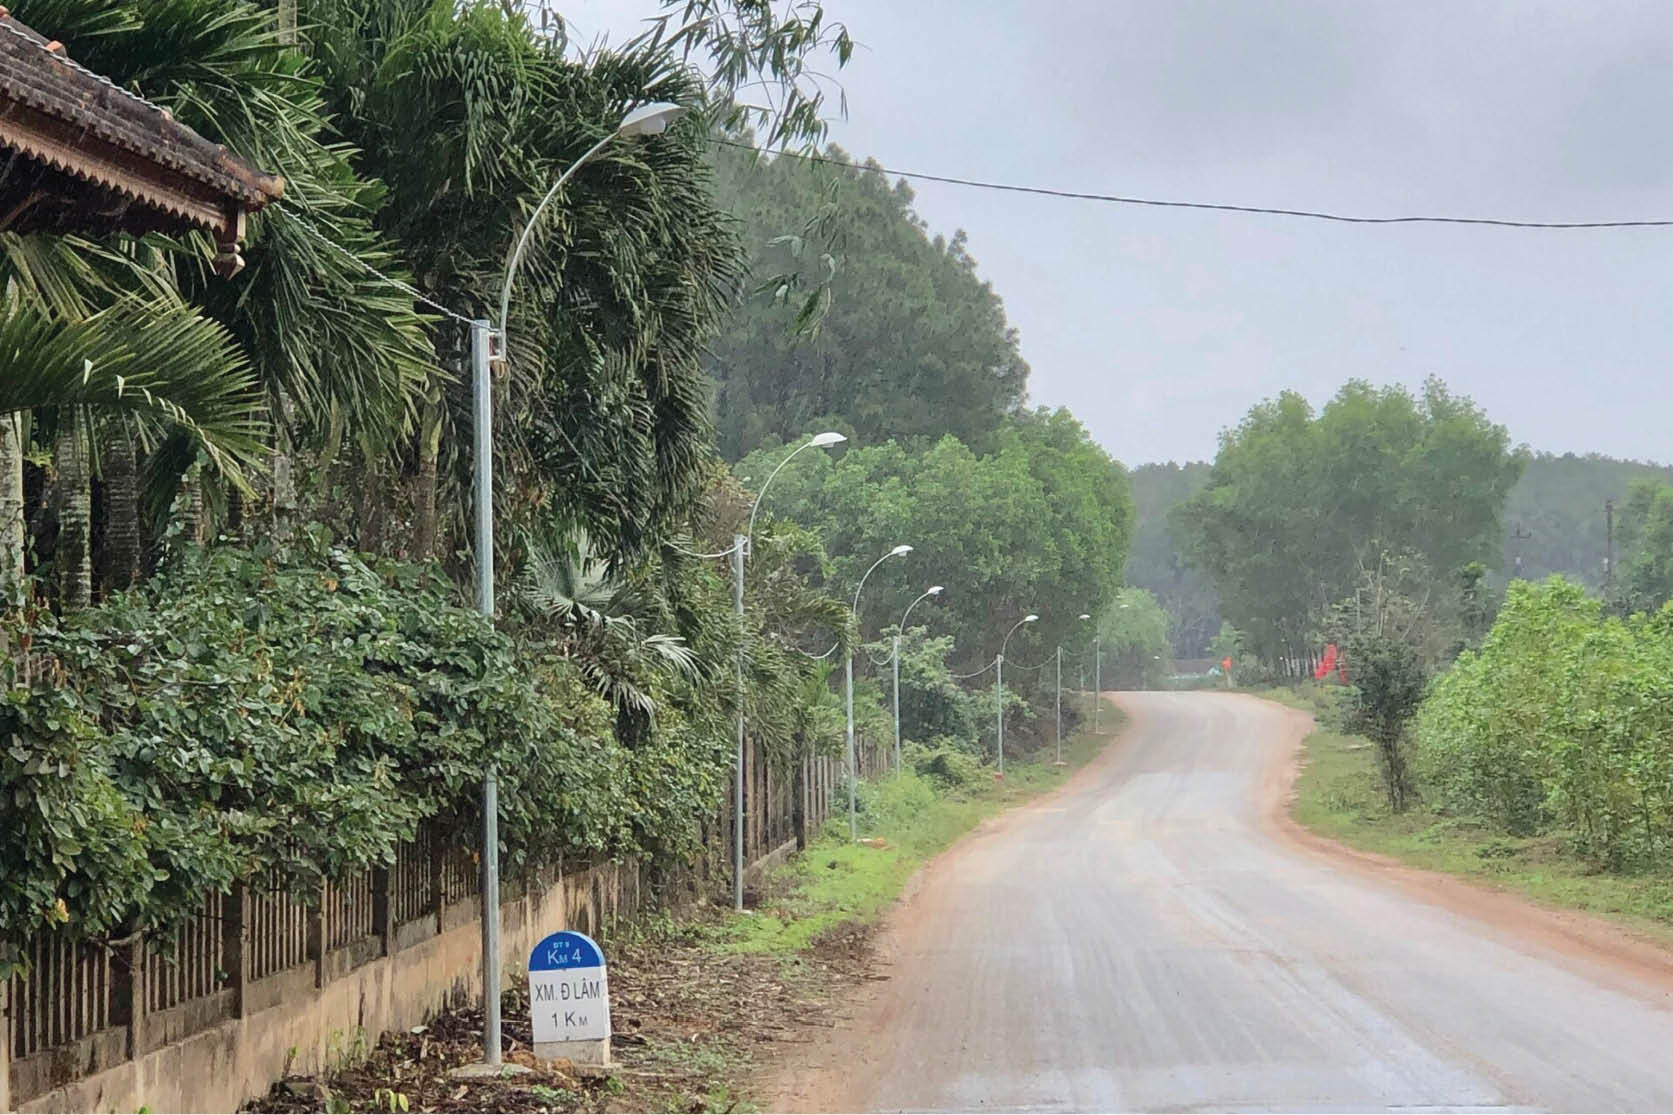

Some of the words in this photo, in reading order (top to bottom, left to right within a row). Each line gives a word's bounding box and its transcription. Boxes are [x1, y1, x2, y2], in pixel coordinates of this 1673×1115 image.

[572, 948, 582, 963] 4
[535, 984, 558, 1001] XM.
[551, 1012, 558, 1028] 1
